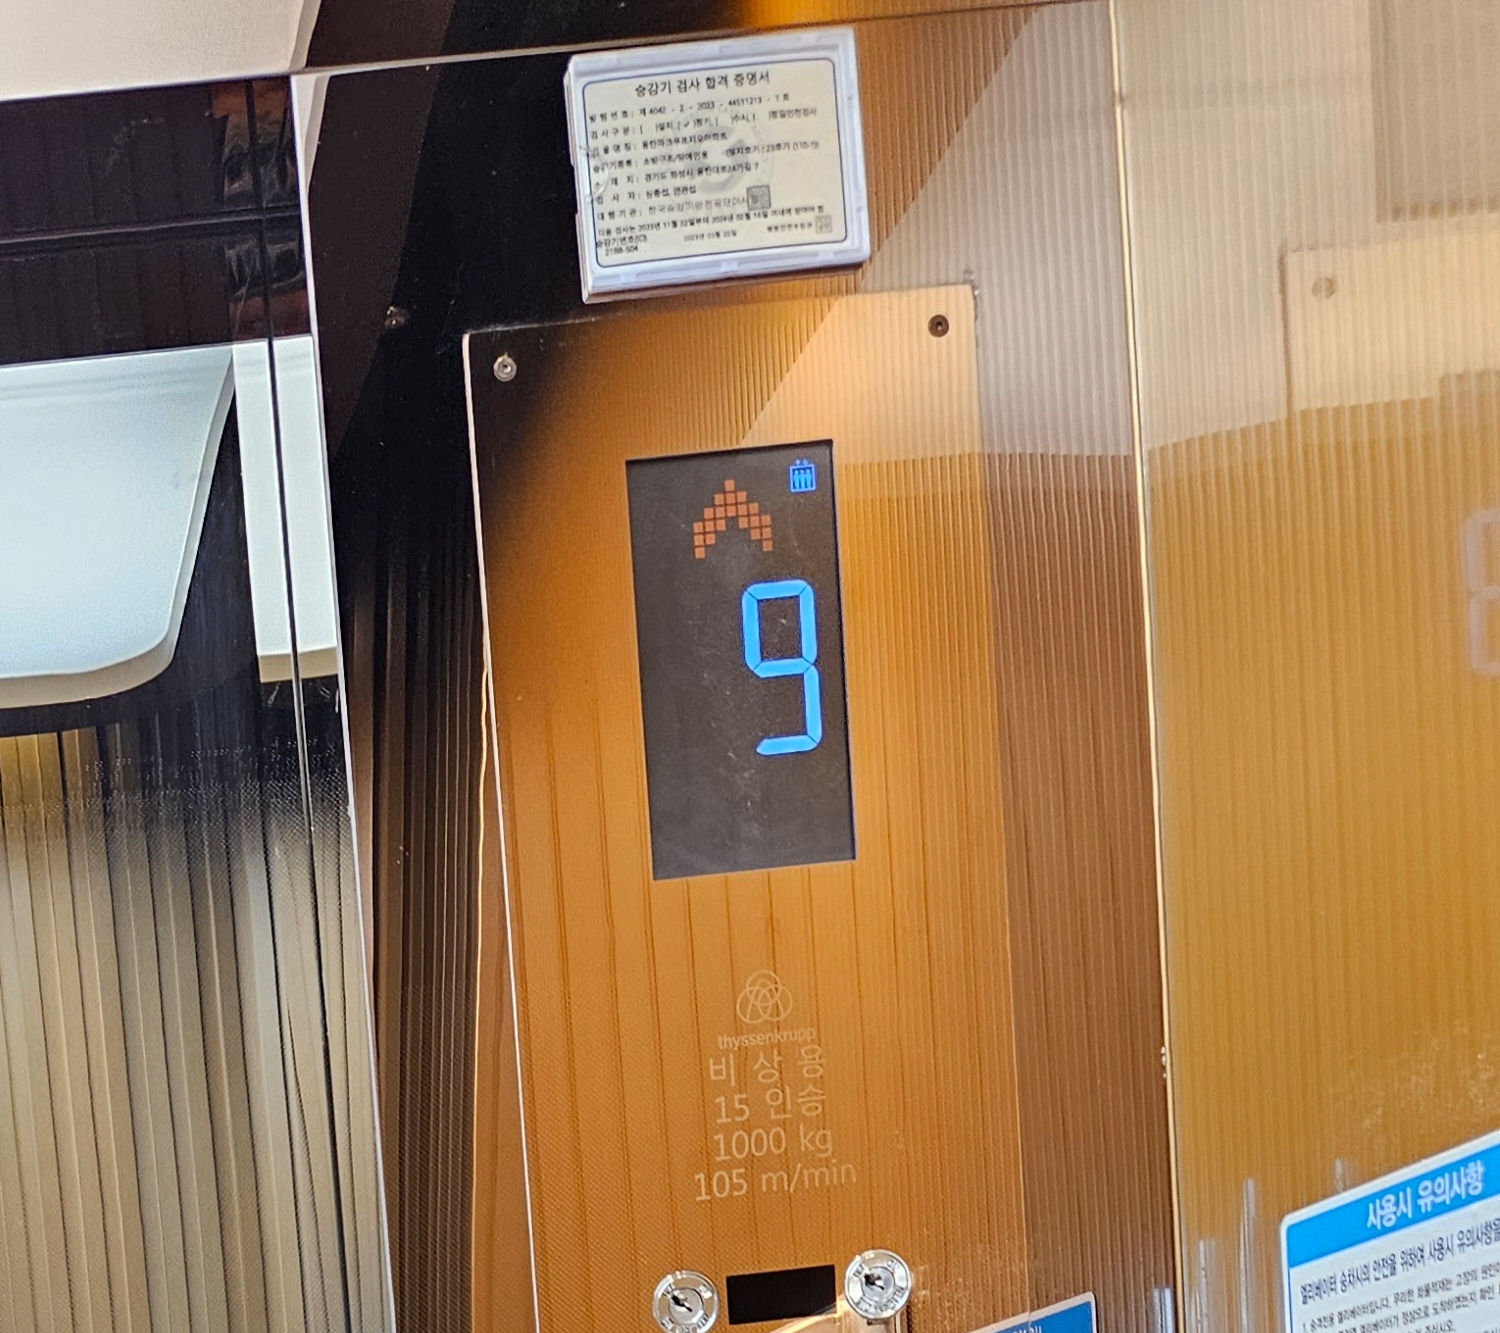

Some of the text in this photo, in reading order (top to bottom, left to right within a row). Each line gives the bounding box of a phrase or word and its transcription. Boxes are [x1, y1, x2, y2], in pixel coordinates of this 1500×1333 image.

[635, 71, 769, 97] 승강기 검사 합격 증명서
[605, 245, 638, 255] 2188-504
[742, 579, 822, 755] 9
[718, 1027, 815, 1050] thyssenkrupp
[716, 1084, 826, 1124] 15 인승
[714, 1124, 832, 1161] 1000 kg
[695, 1159, 857, 1201] 105 m/min
[1367, 1161, 1483, 1228] 사용시 유의사항
[1300, 1275, 1336, 1304] 엘리베이터
[1339, 1263, 1370, 1292] 승차시의
[1372, 1253, 1396, 1281] 안전을
[1400, 1246, 1424, 1270] 위하여
[1428, 1234, 1453, 1261] 사용시
